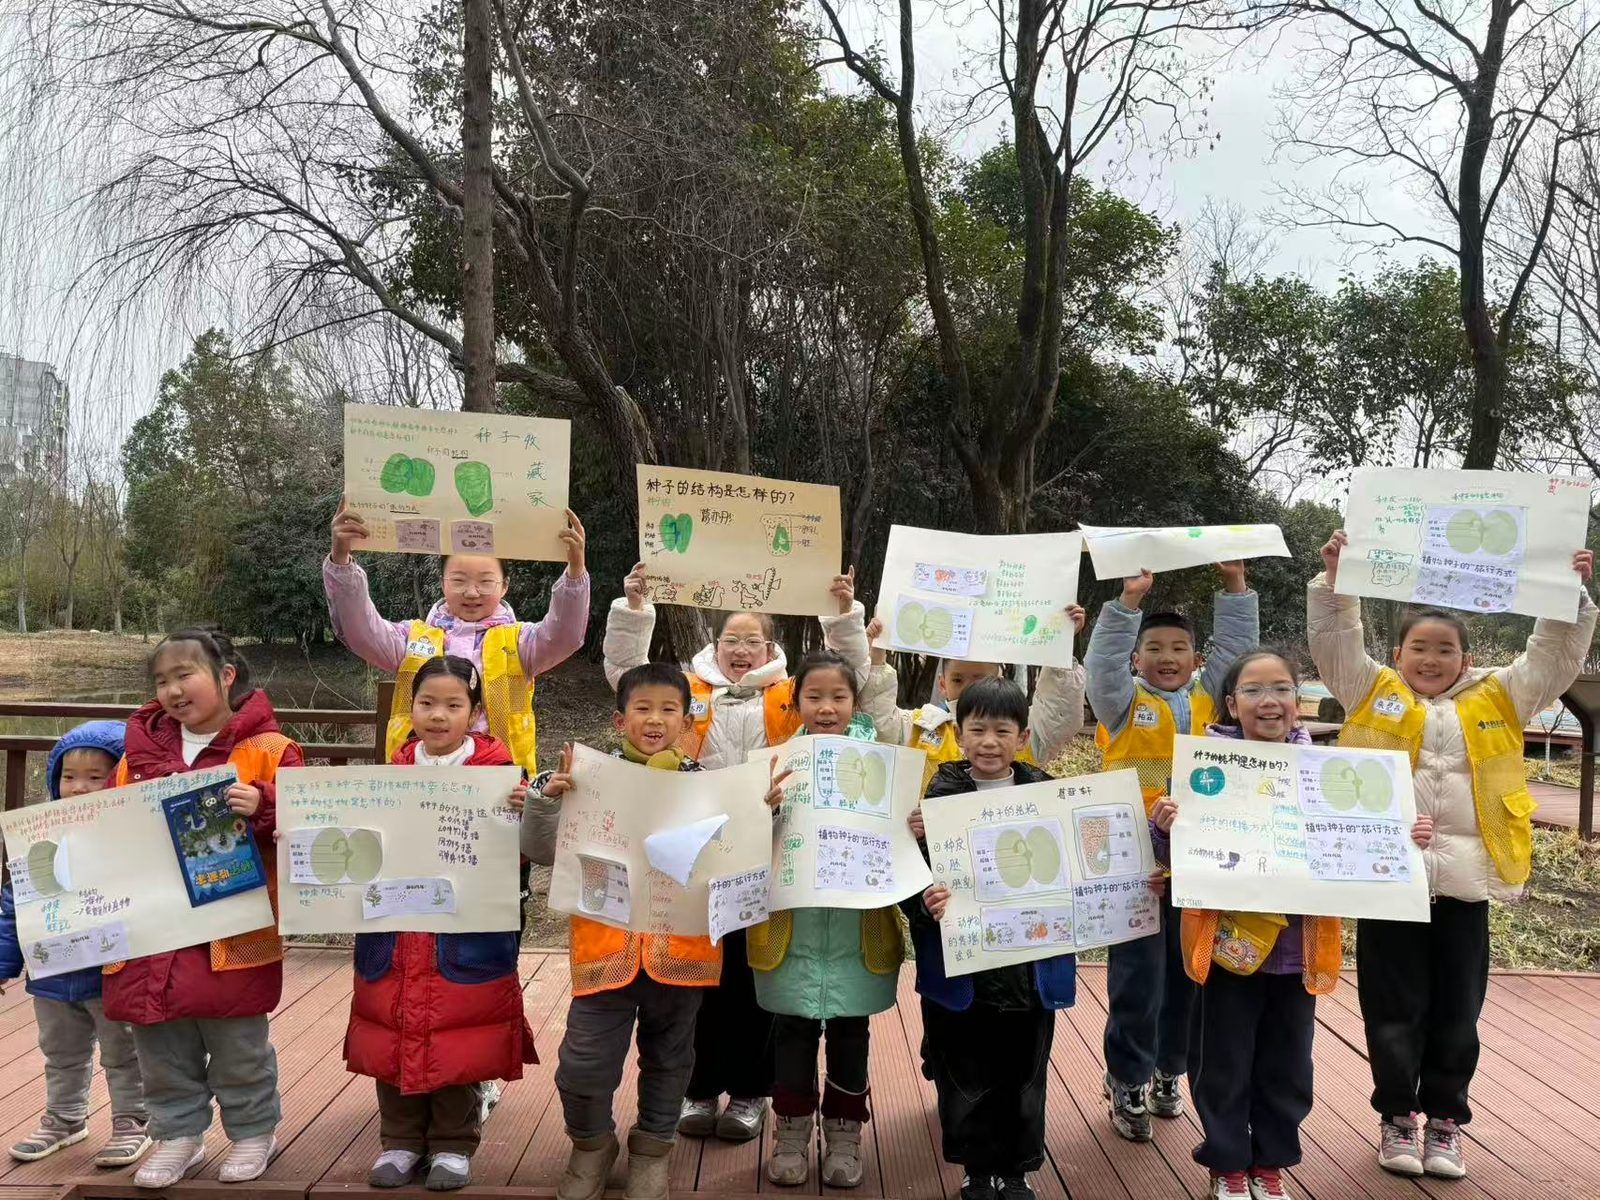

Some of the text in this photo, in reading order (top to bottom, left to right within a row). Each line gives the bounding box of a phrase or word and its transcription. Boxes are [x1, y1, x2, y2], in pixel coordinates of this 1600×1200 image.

[646, 478, 795, 505] 种子的结构是怎样的?
